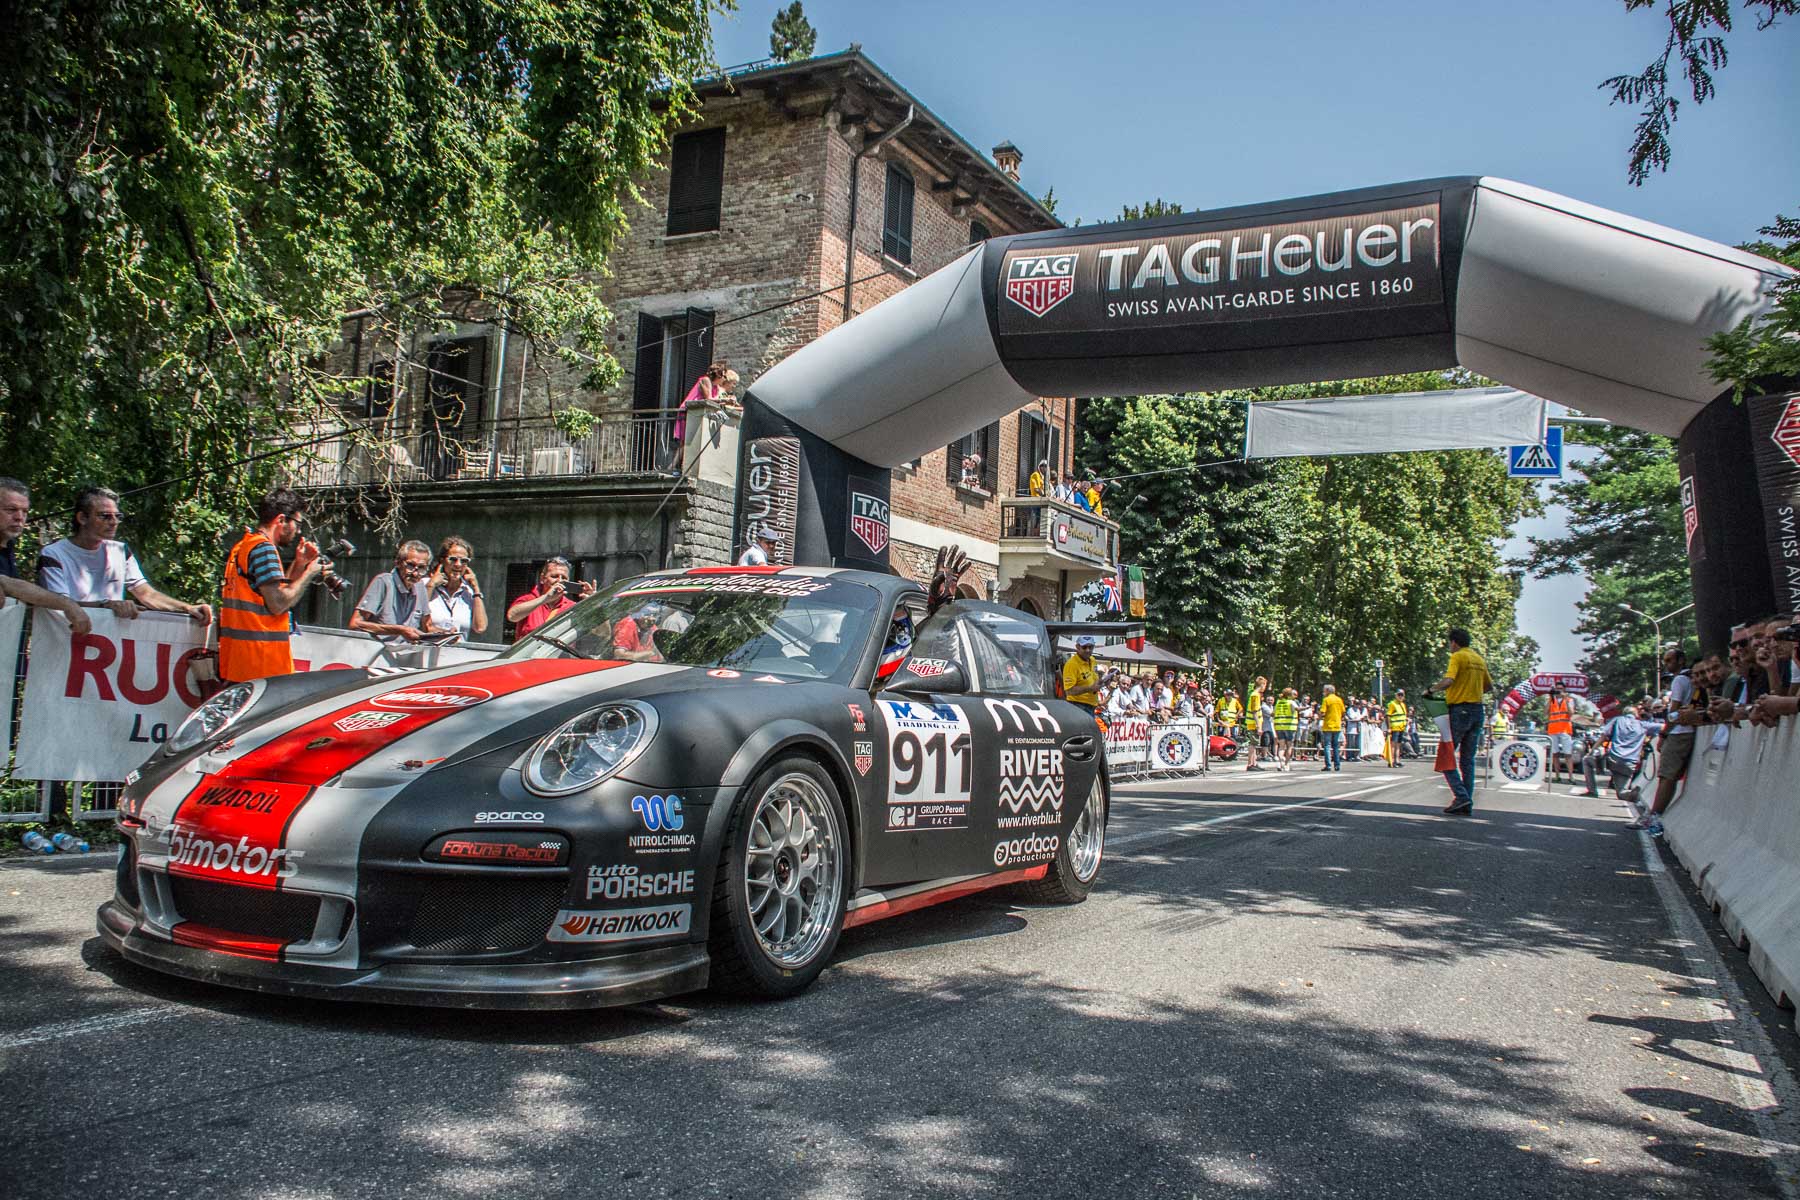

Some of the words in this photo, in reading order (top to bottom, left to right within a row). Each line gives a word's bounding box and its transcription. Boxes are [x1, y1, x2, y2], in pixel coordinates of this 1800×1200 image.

[1015, 257, 1072, 277] TAG
[1009, 279, 1070, 312] HEUER
[1108, 299, 1159, 318] SWISS
[1166, 288, 1295, 315] AVANT-GARDE
[1302, 281, 1361, 302] SINCE
[1371, 276, 1414, 296] 1860
[779, 456, 790, 483] 1860
[776, 488, 788, 527] SINCE
[857, 496, 888, 523] TAG
[1779, 506, 1799, 559] SWISS
[705, 584, 765, 593] RACE
[763, 587, 812, 597] CUP
[908, 664, 945, 676] HEUER
[914, 658, 944, 667] TAG
[360, 713, 403, 721] TAG
[897, 721, 939, 729] TRADING
[130, 713, 168, 744] La
[855, 744, 872, 755] TAG
[855, 755, 872, 773] HEUER
[892, 730, 971, 795] 911
[1000, 749, 1065, 776] RIVER
[474, 811, 545, 823] sparco
[920, 805, 945, 814] GRUPPO
[945, 804, 965, 813] Peroni
[931, 816, 953, 825] RACE
[998, 811, 1062, 829] www.riverblu.it
[628, 834, 696, 847] NITROLCHIMICA
[440, 841, 503, 858] Fortuna
[504, 845, 559, 861] Racing
[1007, 852, 1056, 864] productions
[588, 865, 639, 877] tutto
[586, 870, 696, 900] PORSCHE
